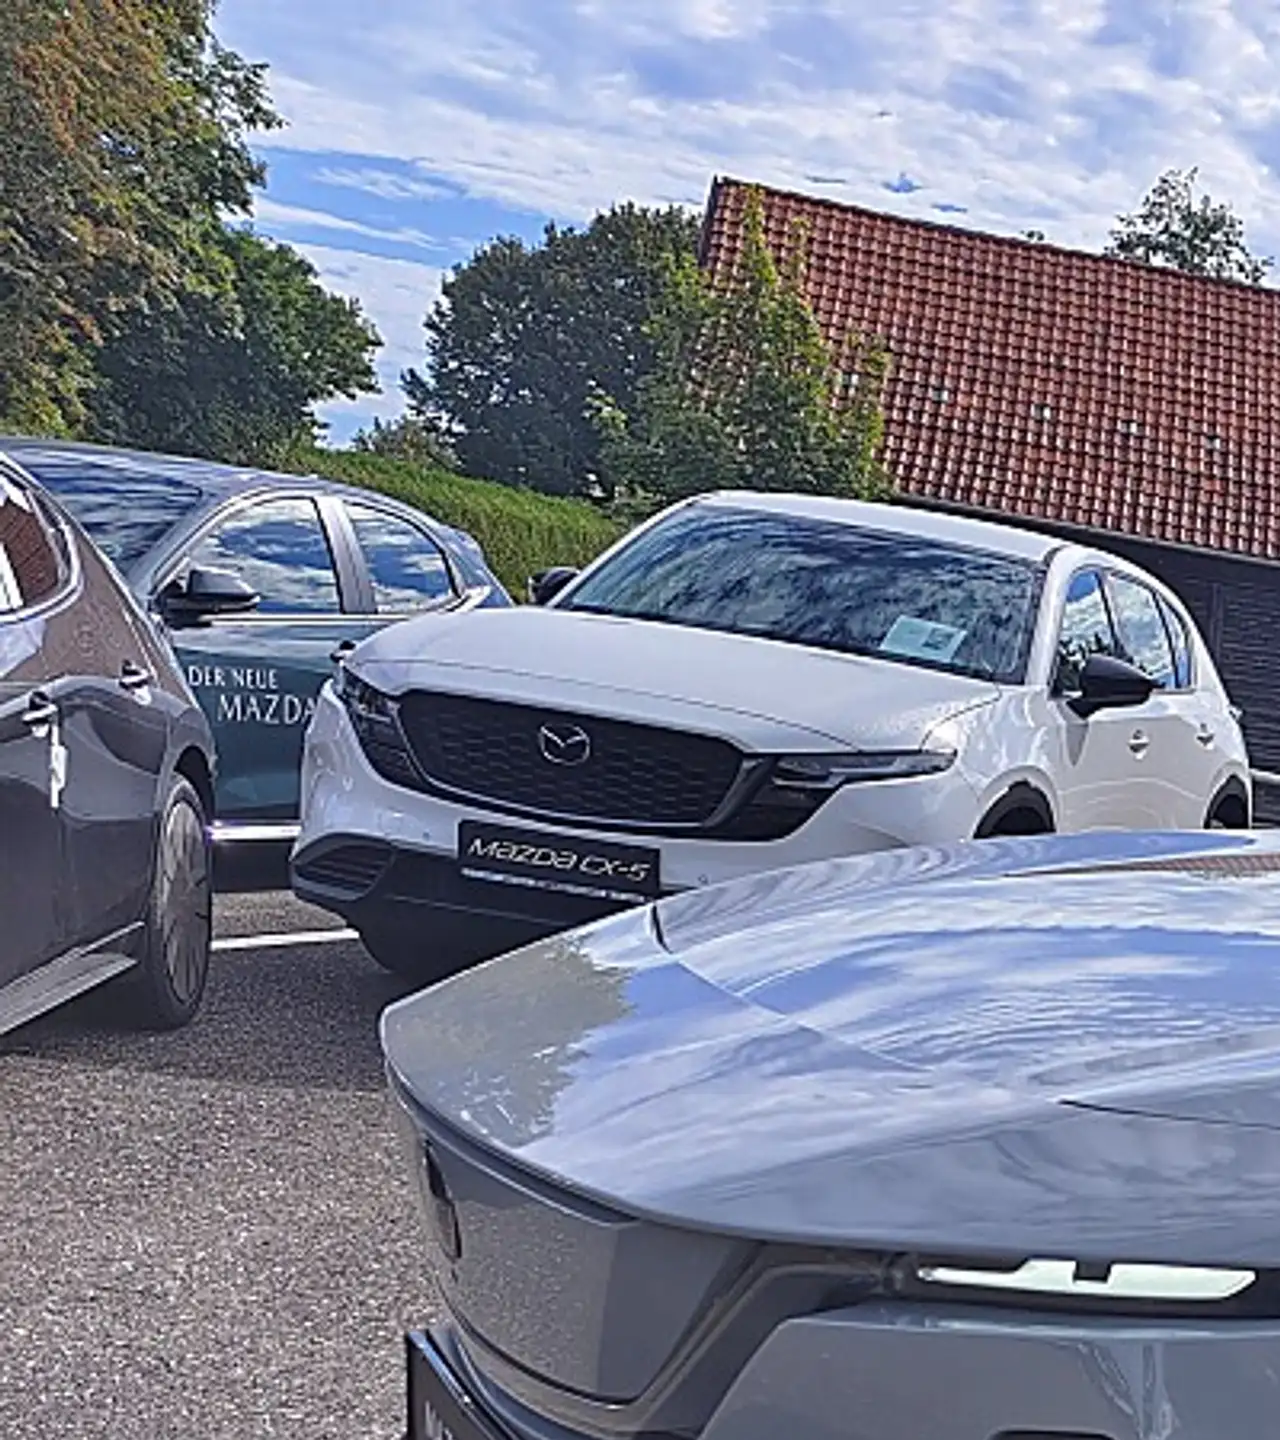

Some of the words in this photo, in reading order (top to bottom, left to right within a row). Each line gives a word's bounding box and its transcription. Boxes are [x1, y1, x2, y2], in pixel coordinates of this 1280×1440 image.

[188, 666, 225, 686] DER
[232, 668, 278, 689] NEUE
[217, 694, 315, 725] MAZDA
[579, 855, 650, 881] CX-5
